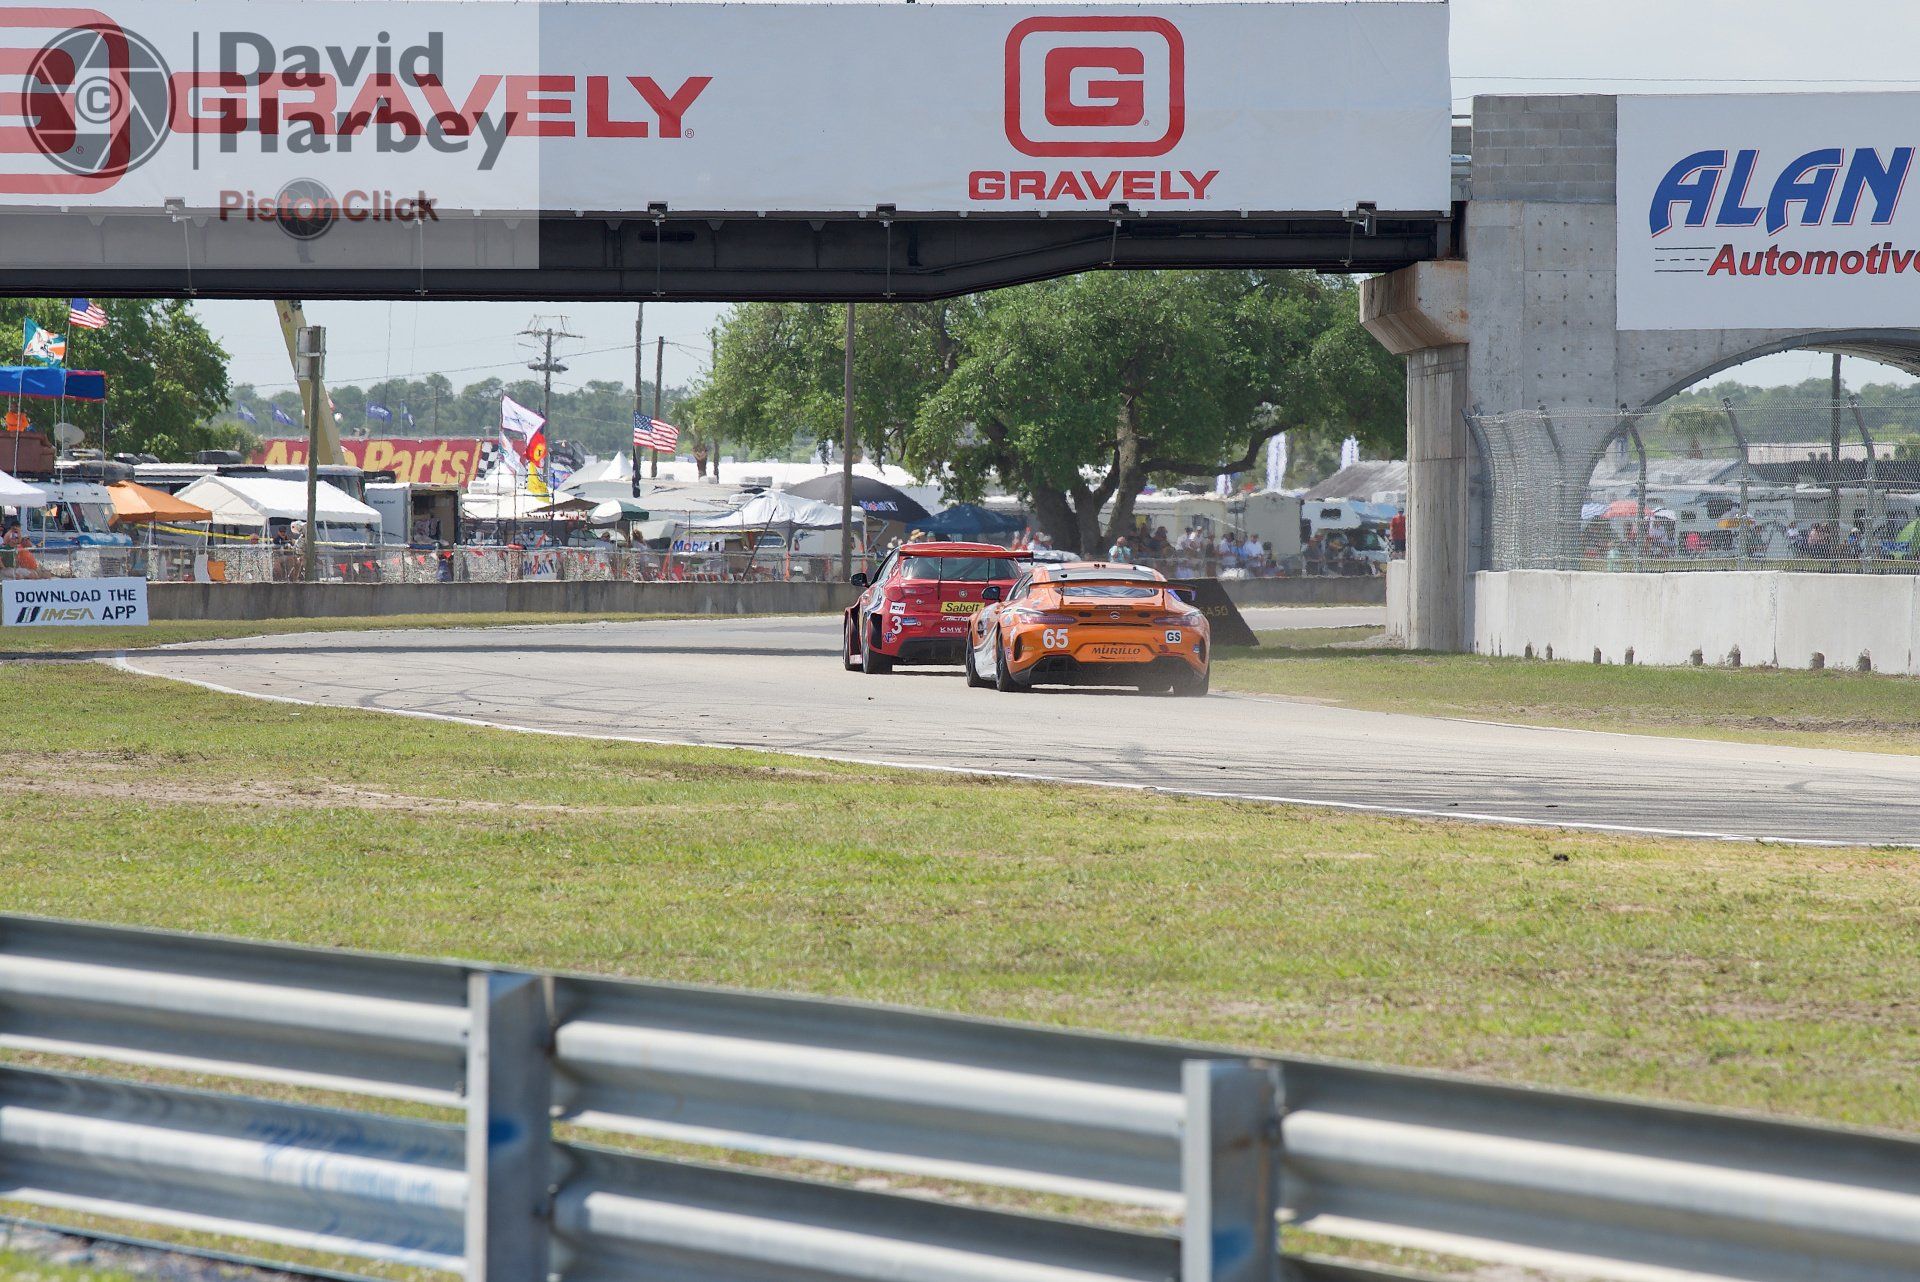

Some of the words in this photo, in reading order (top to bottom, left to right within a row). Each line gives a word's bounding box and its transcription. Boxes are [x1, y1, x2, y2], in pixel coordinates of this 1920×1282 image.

[168, 71, 713, 139] GRAVELY
[968, 170, 1220, 201] GRAVELY
[1649, 147, 1916, 238] ALAN
[15, 589, 101, 603] DOWNLOAD
[108, 588, 136, 601] THE
[41, 608, 94, 621] IMSA
[102, 605, 137, 620] APP
[945, 603, 980, 613] Sabelt
[891, 615, 903, 635] 3
[1042, 628, 1069, 649] 65
[1167, 632, 1181, 642] GS
[1091, 647, 1141, 655] MURILLO
